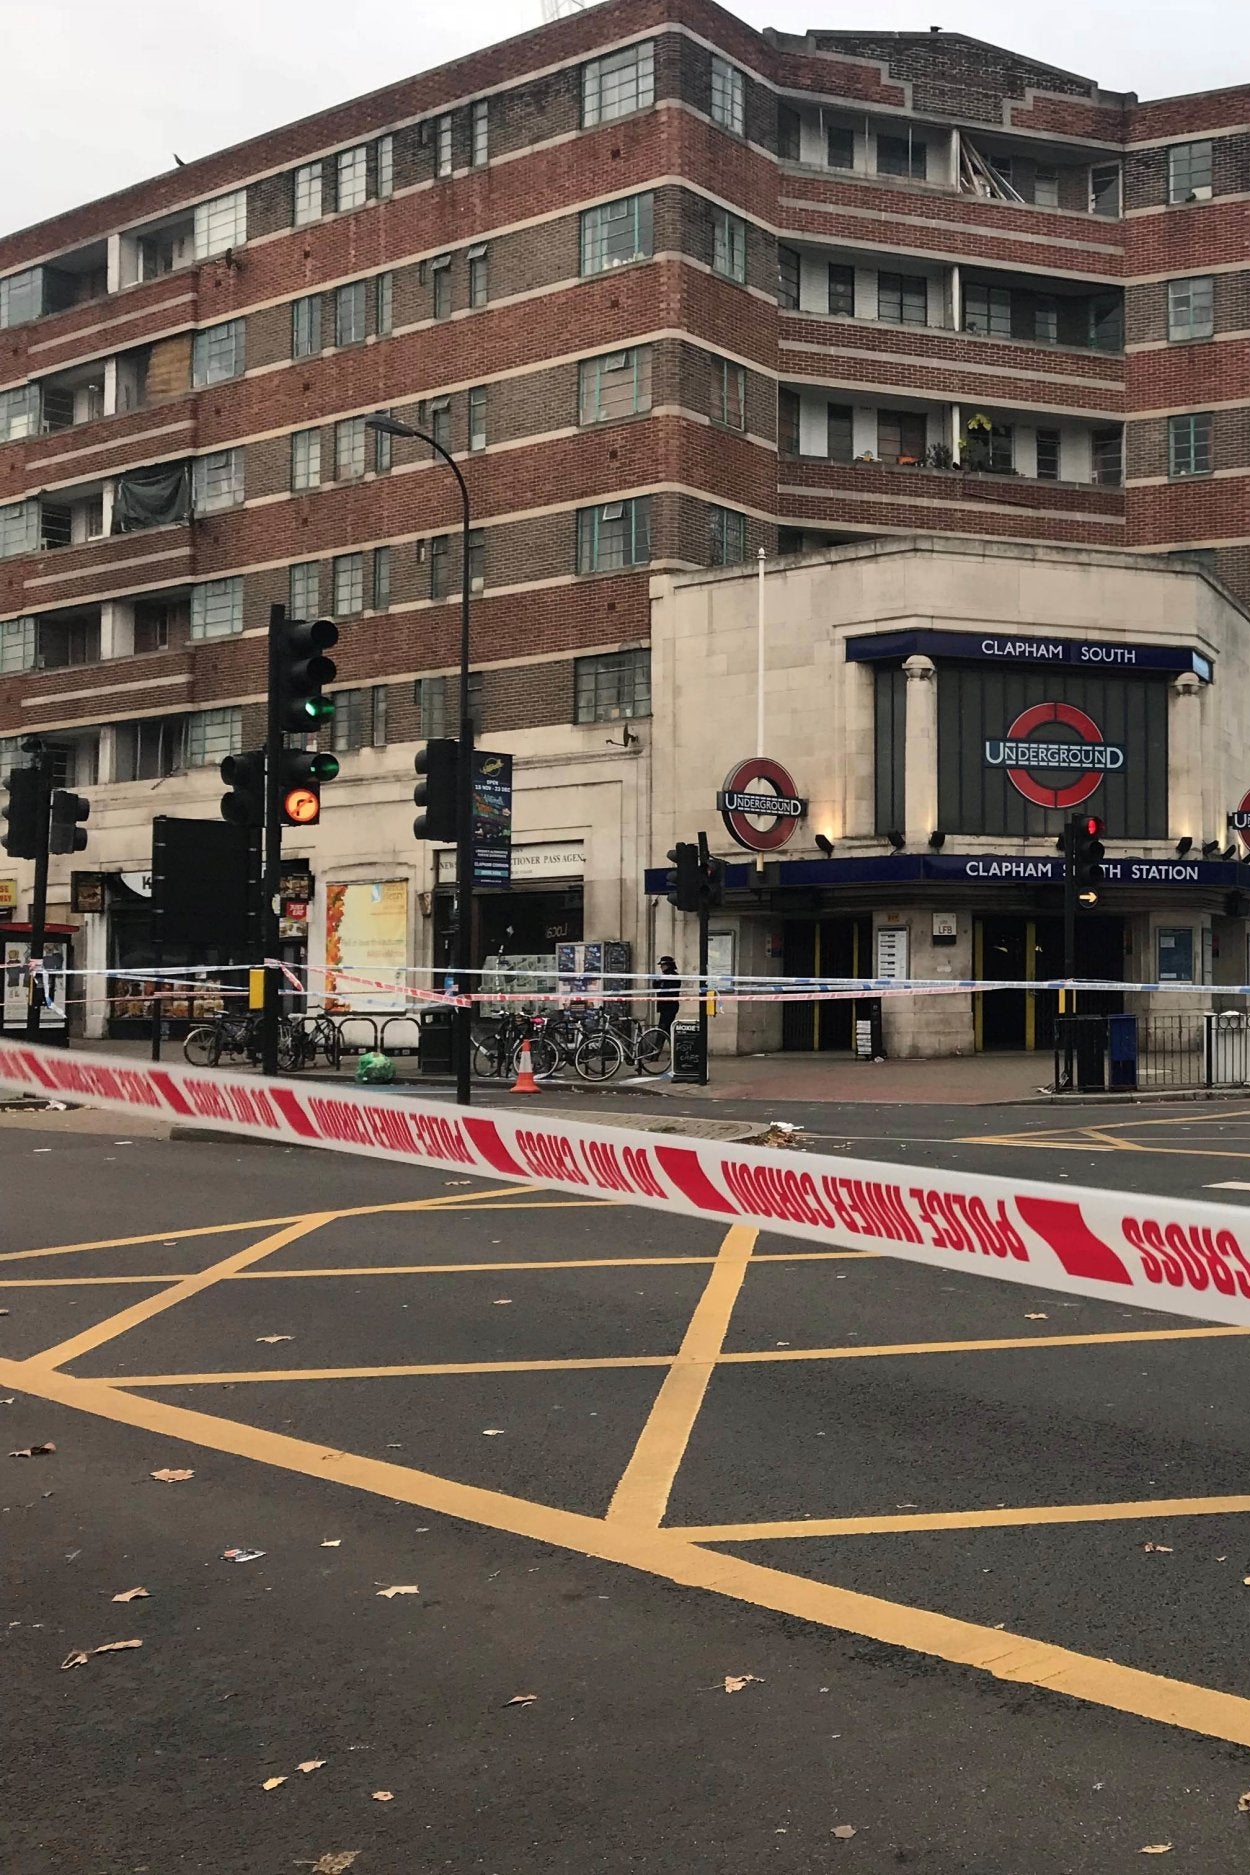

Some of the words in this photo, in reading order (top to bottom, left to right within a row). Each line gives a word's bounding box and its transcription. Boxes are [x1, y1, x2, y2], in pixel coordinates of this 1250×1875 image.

[981, 640, 1063, 659] CLAPHAM
[1081, 646, 1136, 664] SOUTH
[985, 741, 1124, 769] UNDERGROUND
[725, 793, 801, 815] UNDERGROUND
[966, 861, 1052, 878] CLAPHAM
[1131, 865, 1198, 881] STATION
[938, 925, 953, 934] LFB
[363, 1105, 423, 1155] INNER
[409, 1112, 477, 1165] POLICE
[515, 1129, 589, 1185] CROSS
[579, 1139, 635, 1193] NOT
[622, 1145, 669, 1200] DO
[720, 1159, 836, 1230] CORDON
[821, 1174, 925, 1246] INNER
[908, 1187, 1030, 1262] POLICE
